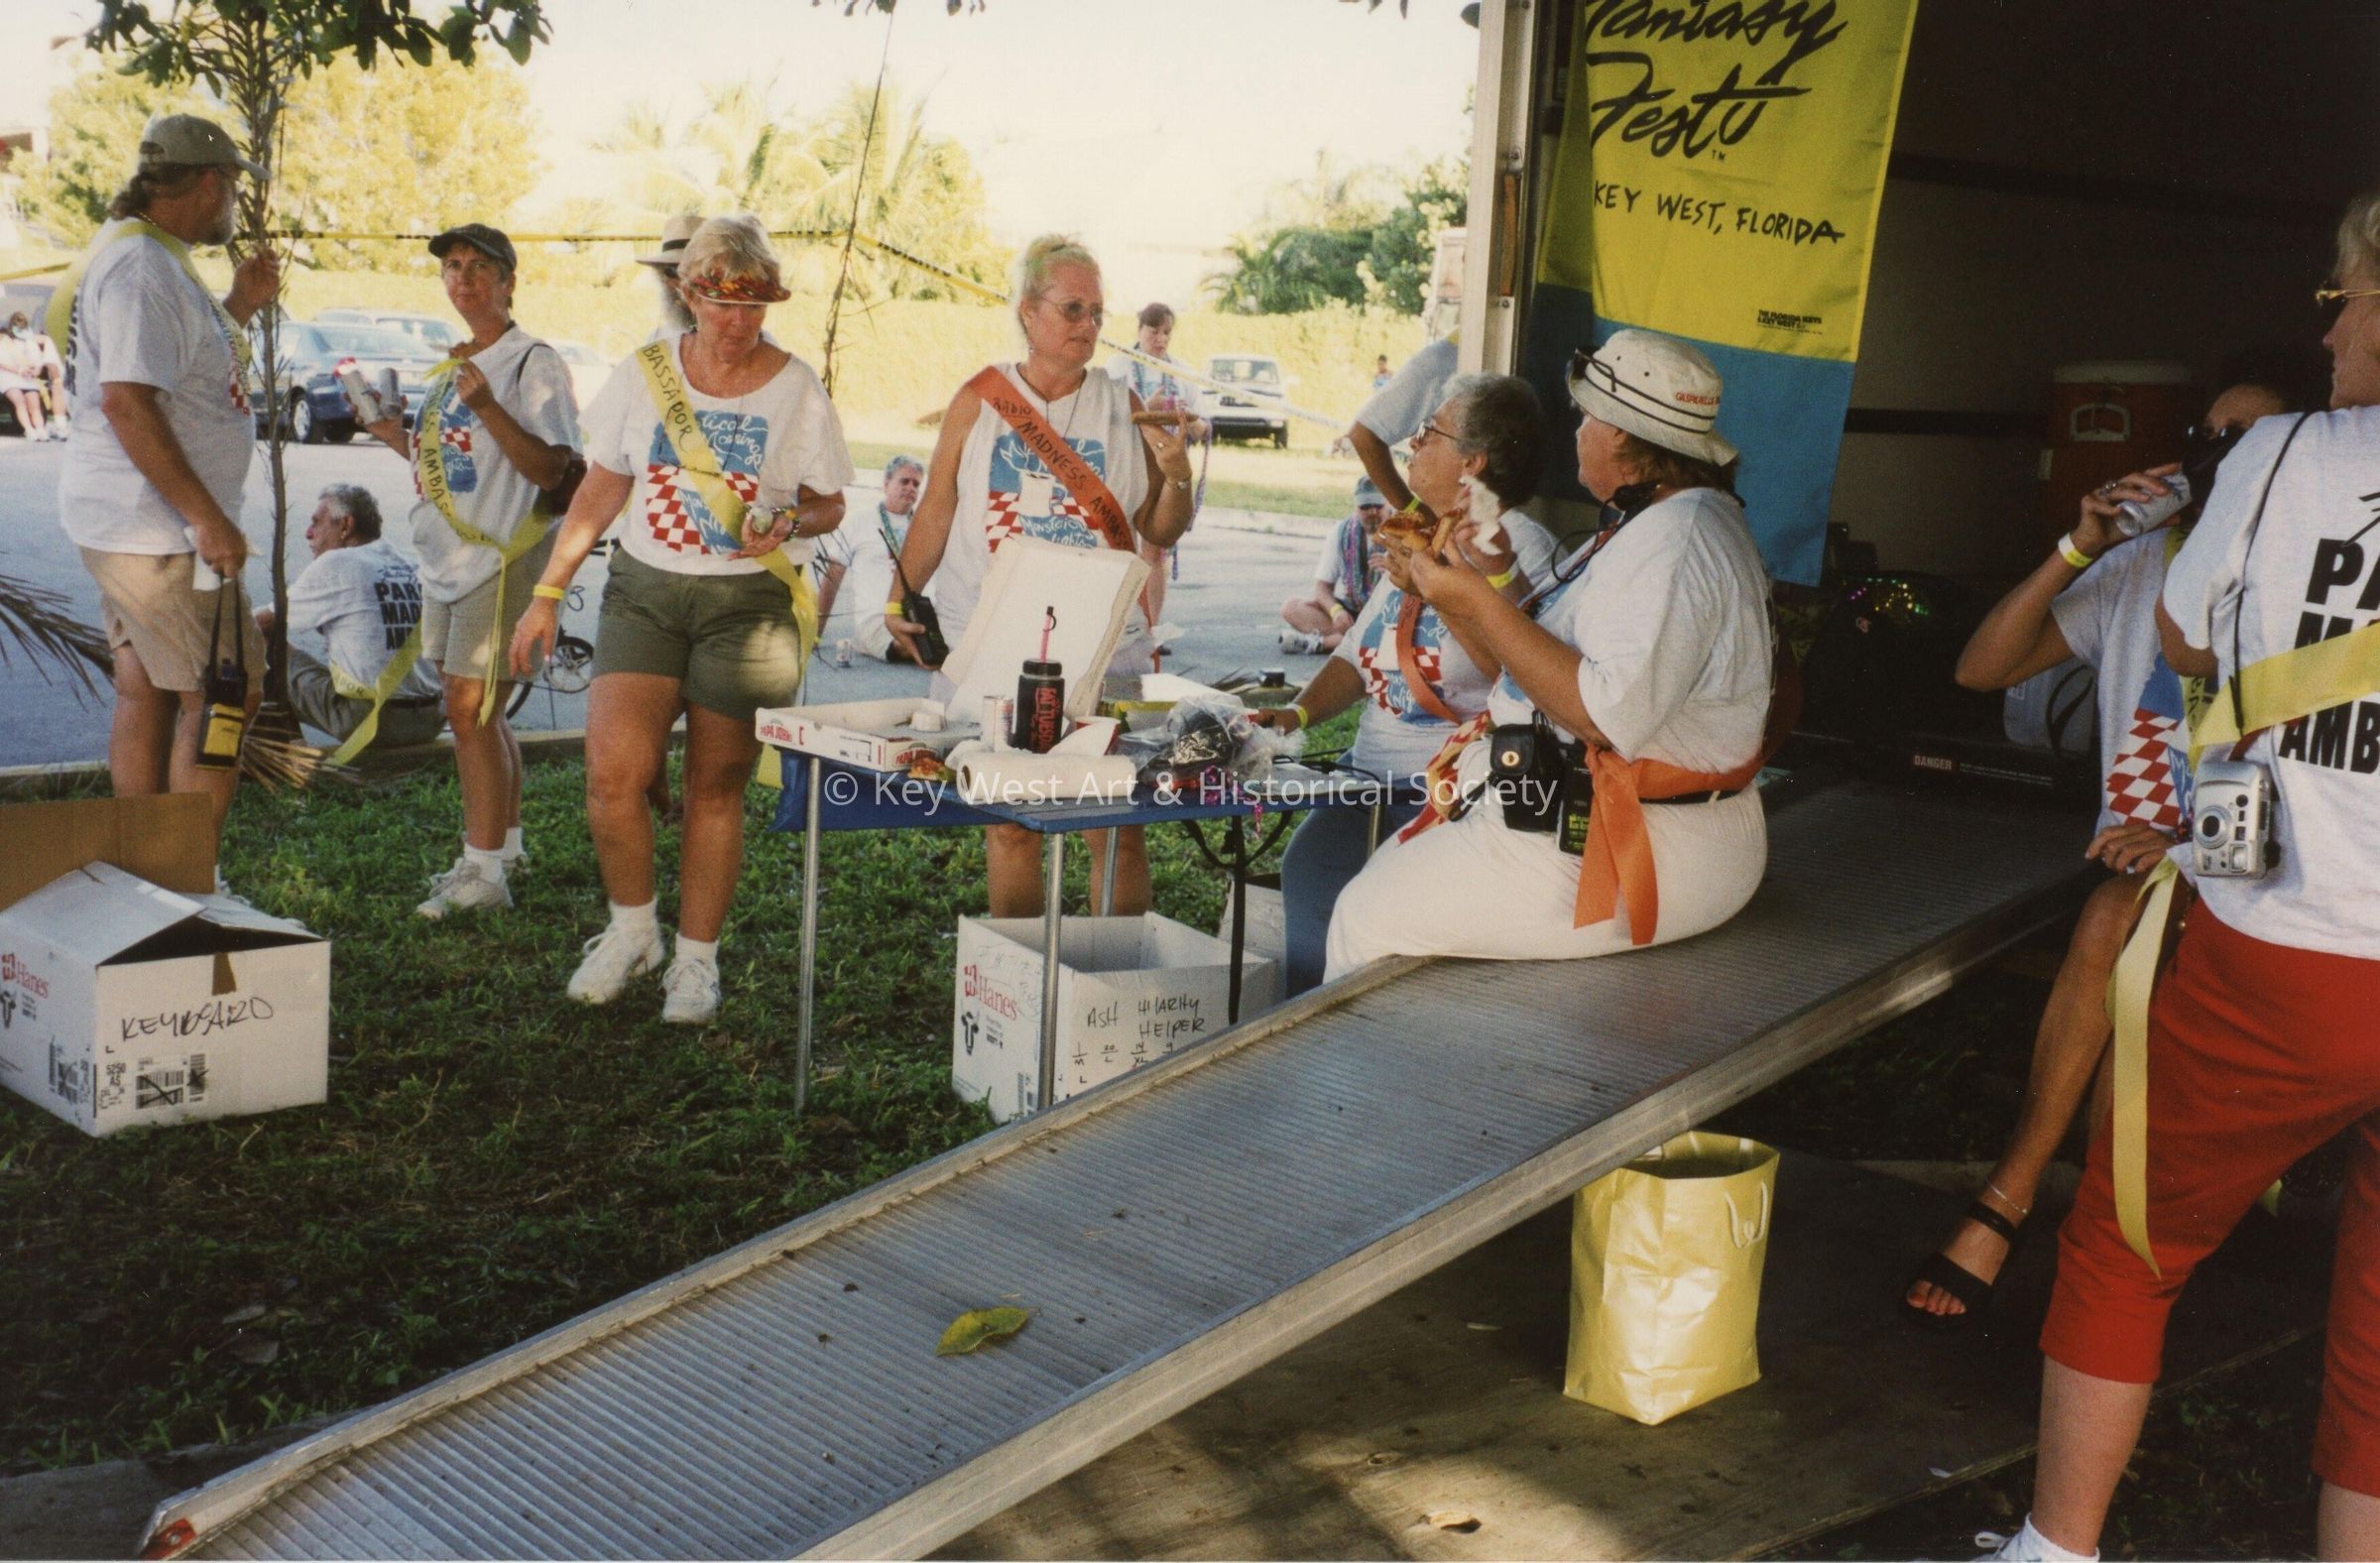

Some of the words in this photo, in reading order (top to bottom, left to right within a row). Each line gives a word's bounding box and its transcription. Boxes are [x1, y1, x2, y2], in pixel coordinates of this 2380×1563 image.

[1587, 52, 1811, 159] Fest
[1594, 180, 1641, 213] KEY
[1657, 192, 1724, 235] WEST,
[1736, 206, 1845, 245] FLORIDA
[1017, 421, 1087, 490] MADNESS
[1914, 755, 1953, 771] DANGER
[16, 961, 49, 999] Hanes
[979, 975, 1017, 1021] Hanes
[1087, 1001, 1119, 1028] ASH
